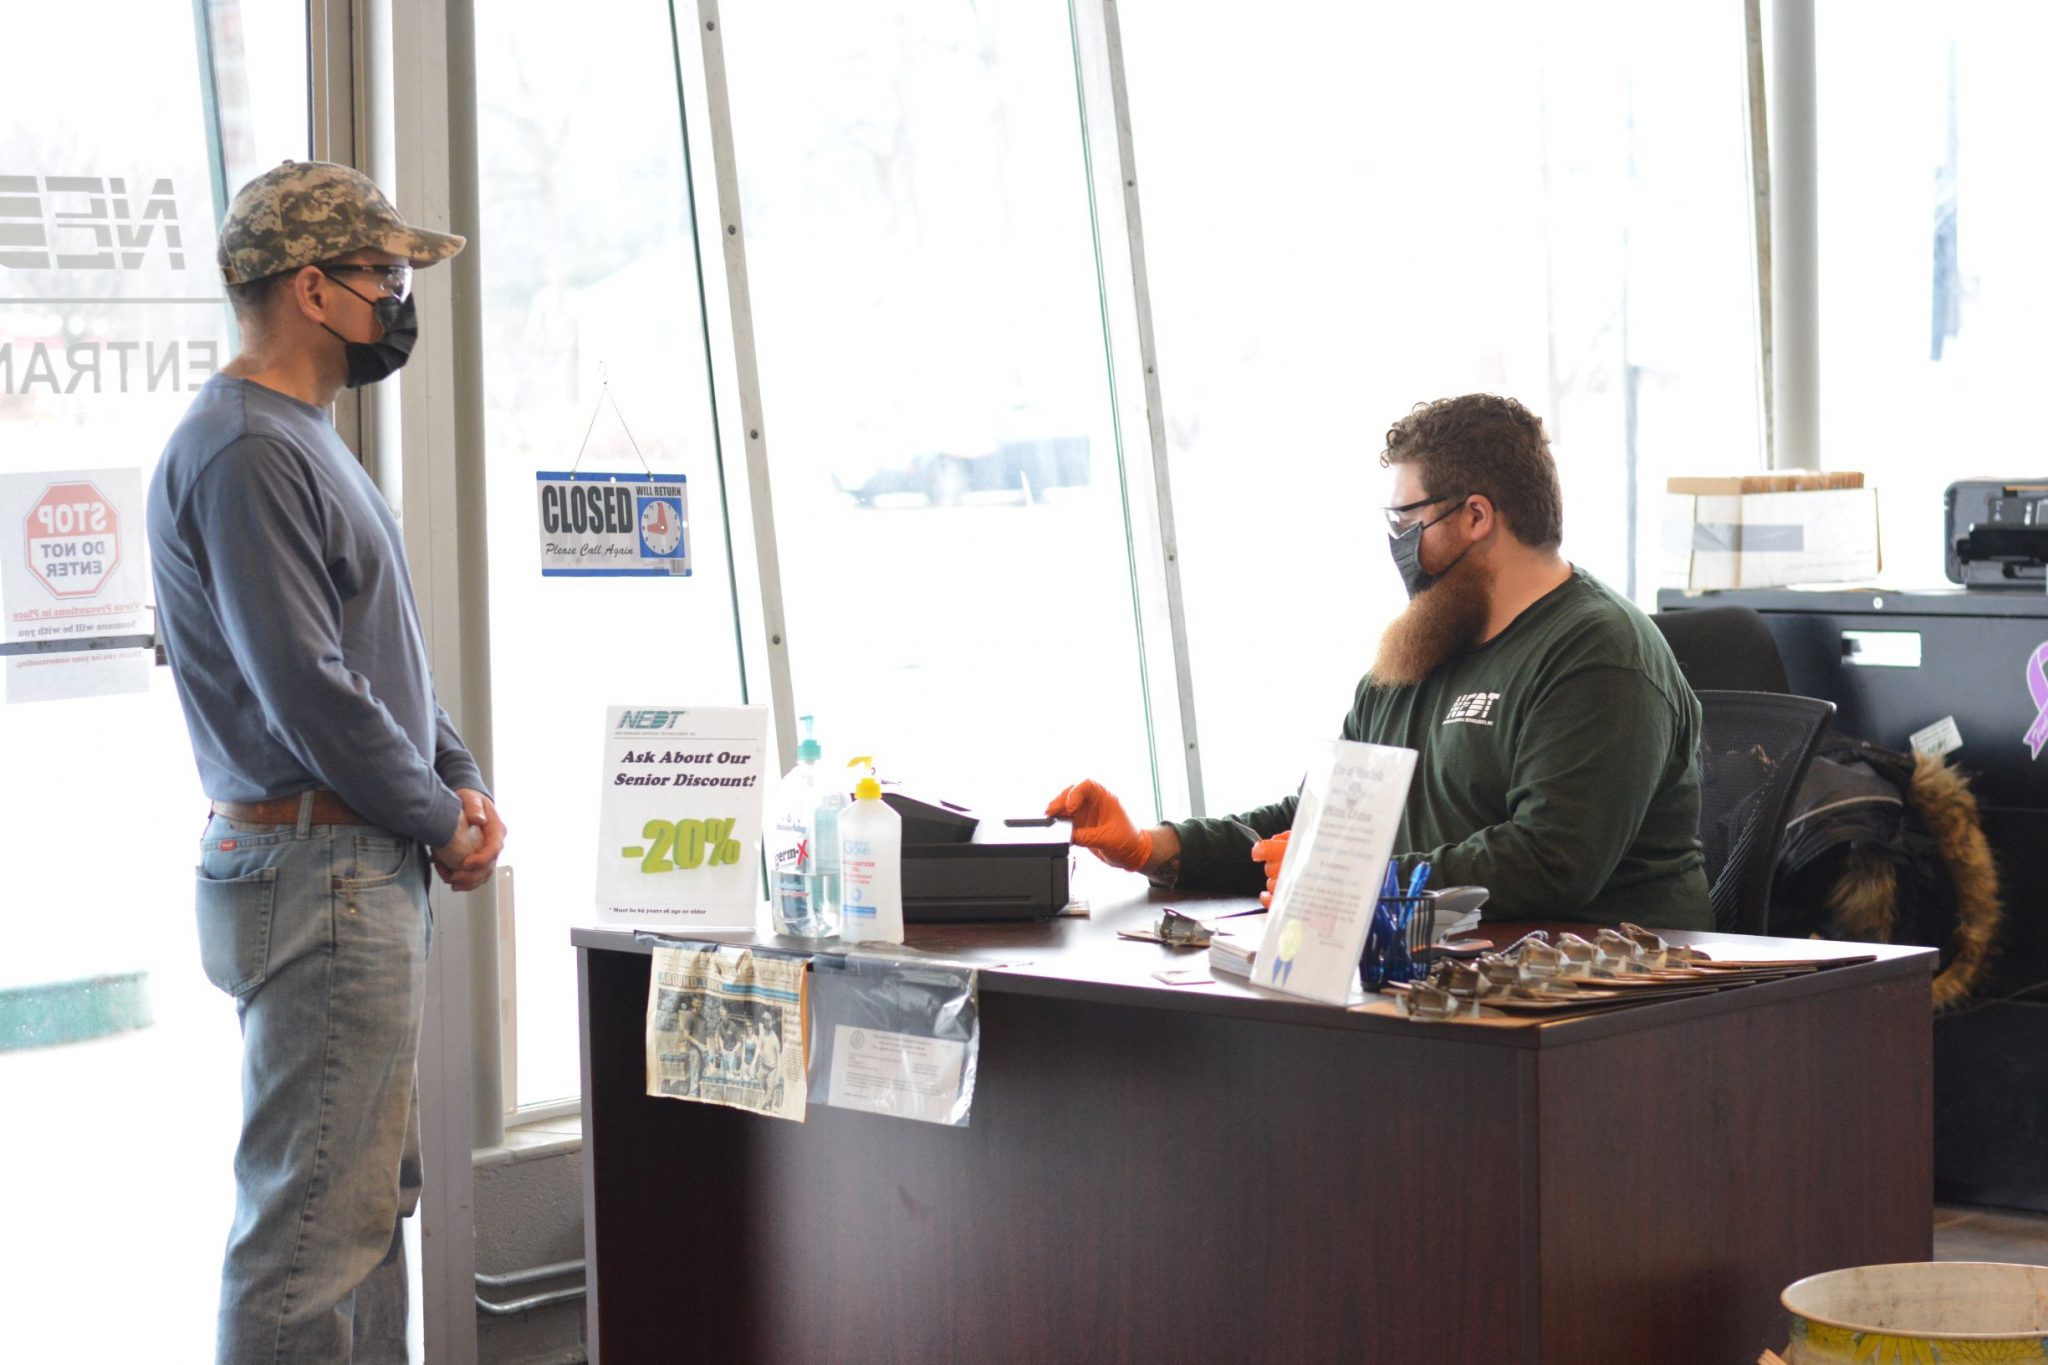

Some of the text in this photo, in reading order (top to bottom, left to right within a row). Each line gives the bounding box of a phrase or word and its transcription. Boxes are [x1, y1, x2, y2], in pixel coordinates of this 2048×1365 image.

[636, 486, 681, 496] WILL RETURN
[542, 485, 633, 534] CLOSED
[545, 543, 634, 558] Please Call Again
[1446, 692, 1500, 719] NEDT
[618, 710, 685, 729] NEDT
[621, 751, 751, 764] Ask About Our
[614, 773, 756, 787] Senior Discount!
[621, 817, 741, 874] -20%
